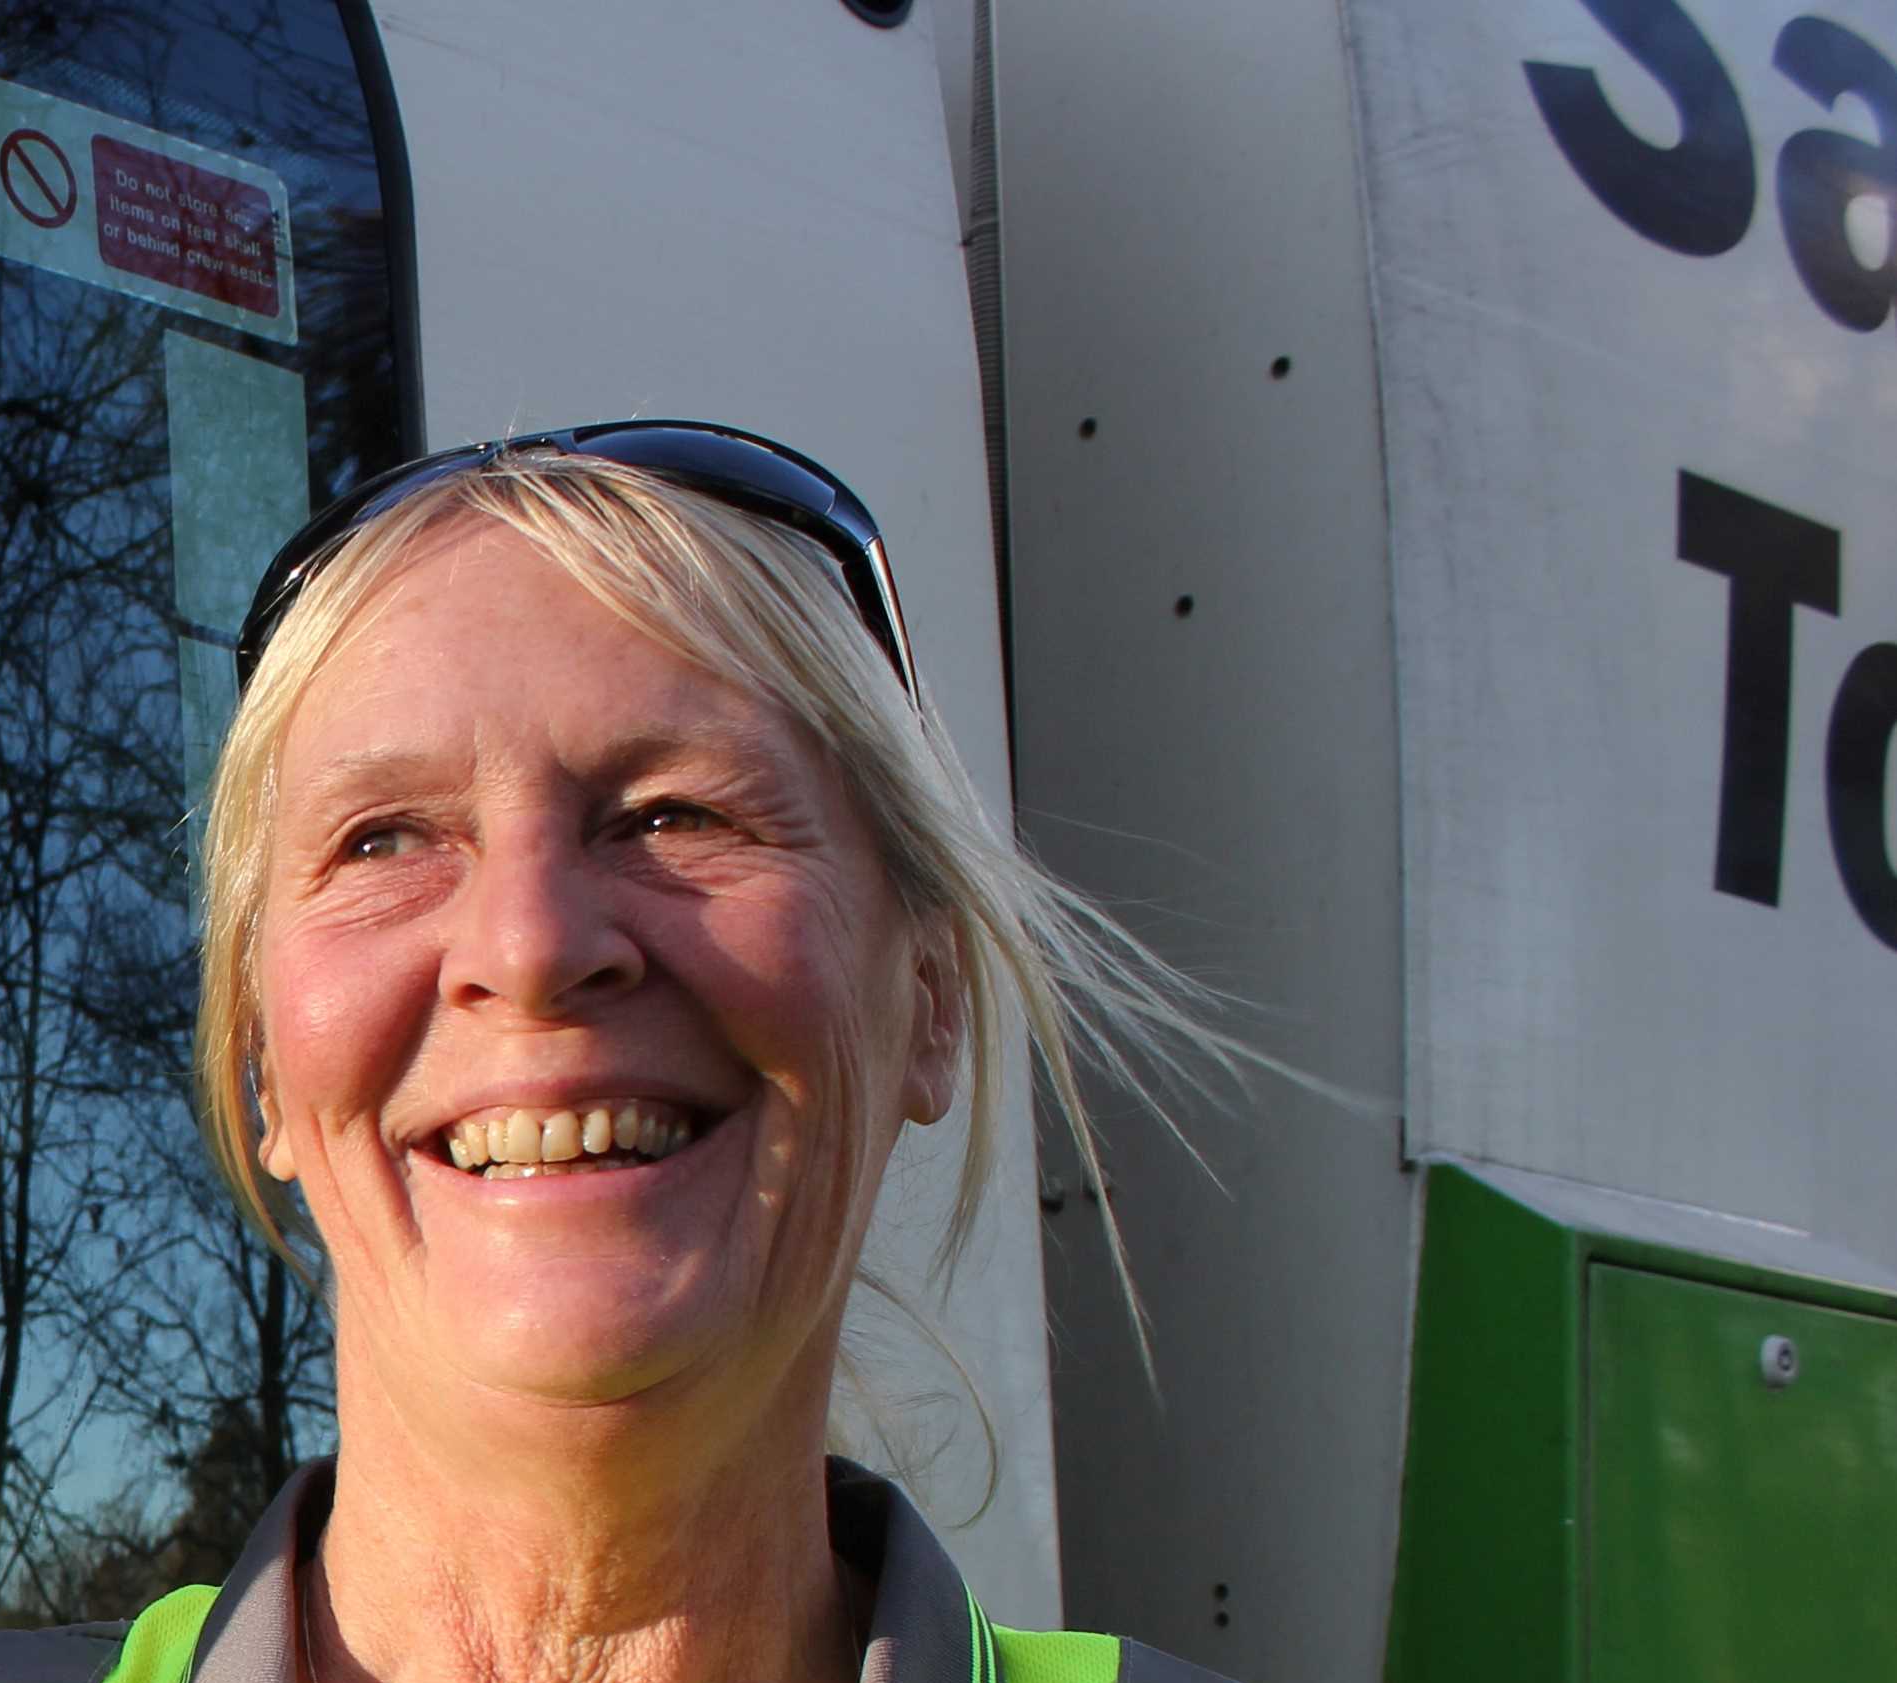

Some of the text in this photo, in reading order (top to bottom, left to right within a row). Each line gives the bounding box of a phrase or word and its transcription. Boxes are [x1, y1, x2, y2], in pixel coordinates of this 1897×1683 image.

[116, 168, 138, 190] Do
[144, 182, 172, 203] not
[179, 192, 219, 217] store
[103, 222, 120, 239] or
[127, 227, 180, 257] behind
[187, 250, 223, 271] crew
[161, 213, 181, 232] on
[186, 223, 217, 244] rear
